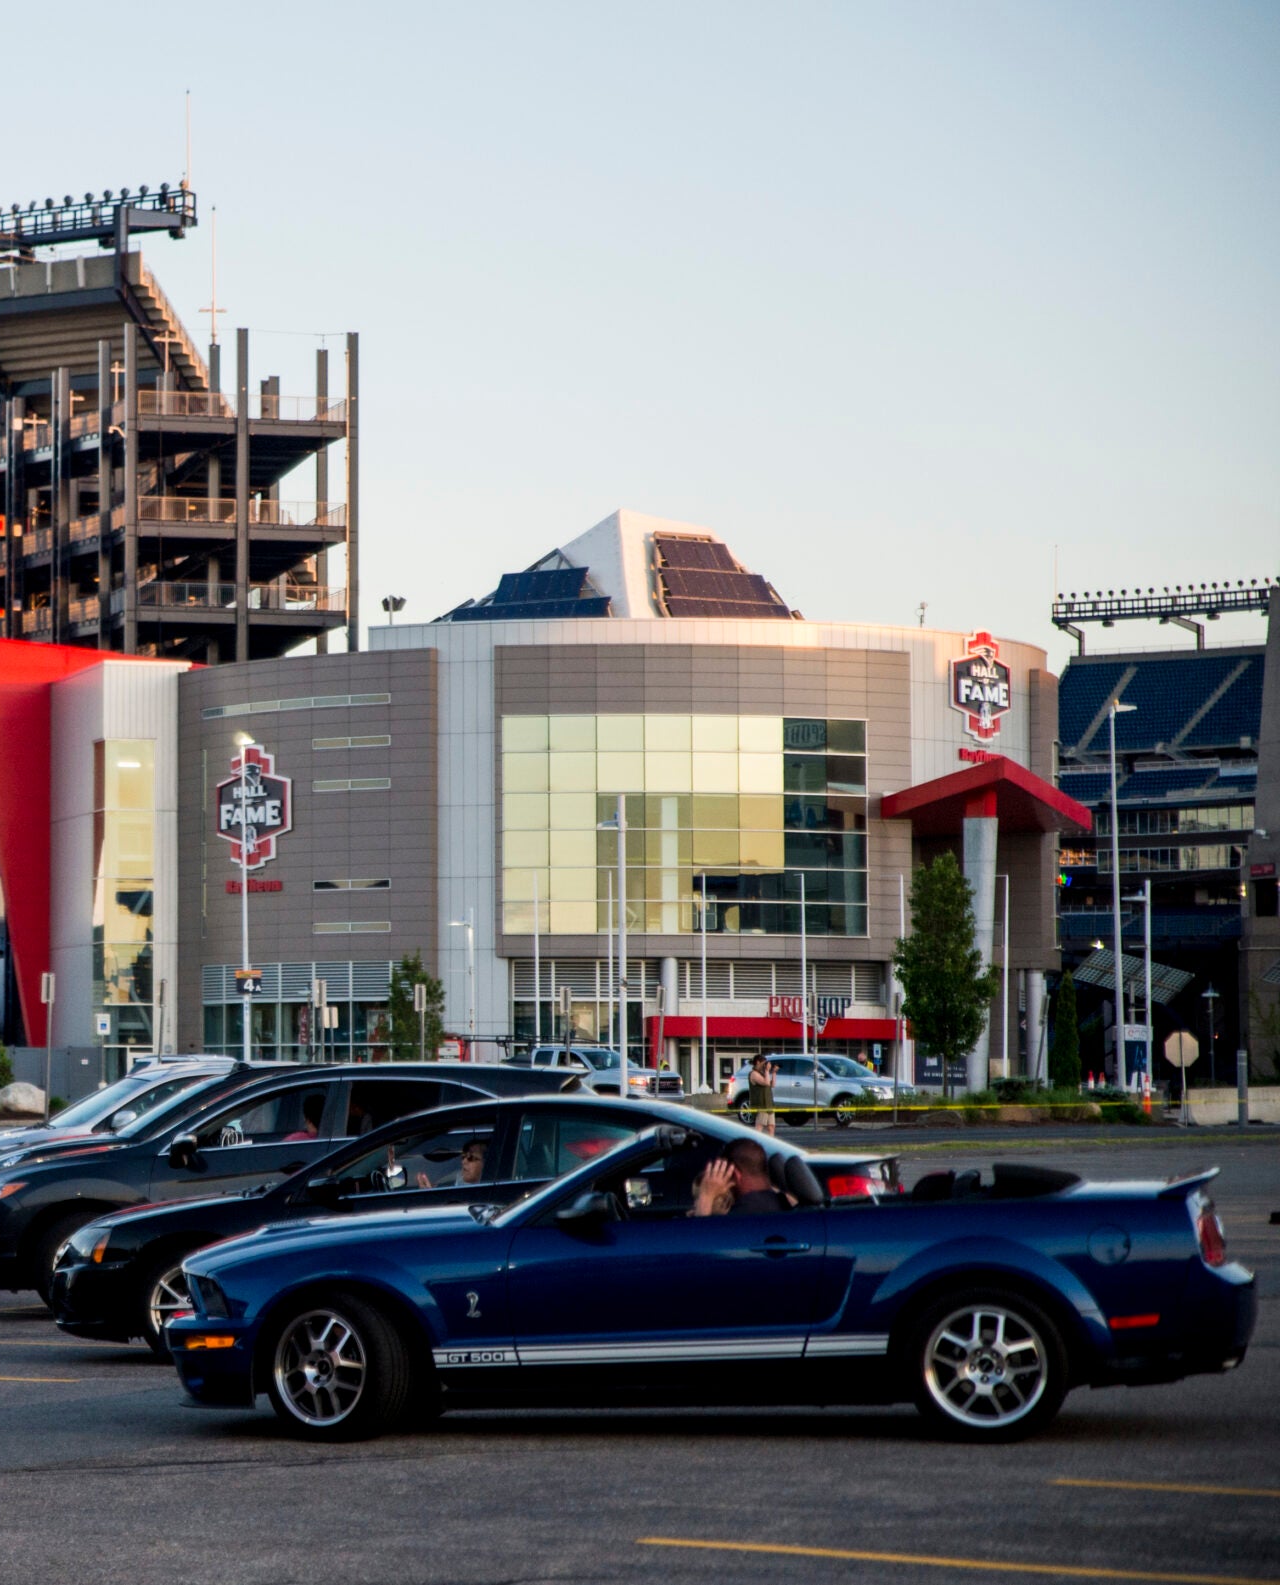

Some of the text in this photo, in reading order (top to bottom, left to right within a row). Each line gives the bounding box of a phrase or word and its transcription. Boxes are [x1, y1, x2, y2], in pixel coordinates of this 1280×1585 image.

[971, 664, 999, 679] HALL
[960, 678, 1009, 707] FAME
[232, 784, 267, 799] HALL
[220, 800, 282, 830] FAME
[769, 996, 804, 1018] PRO
[448, 1351, 504, 1363] GT 500
